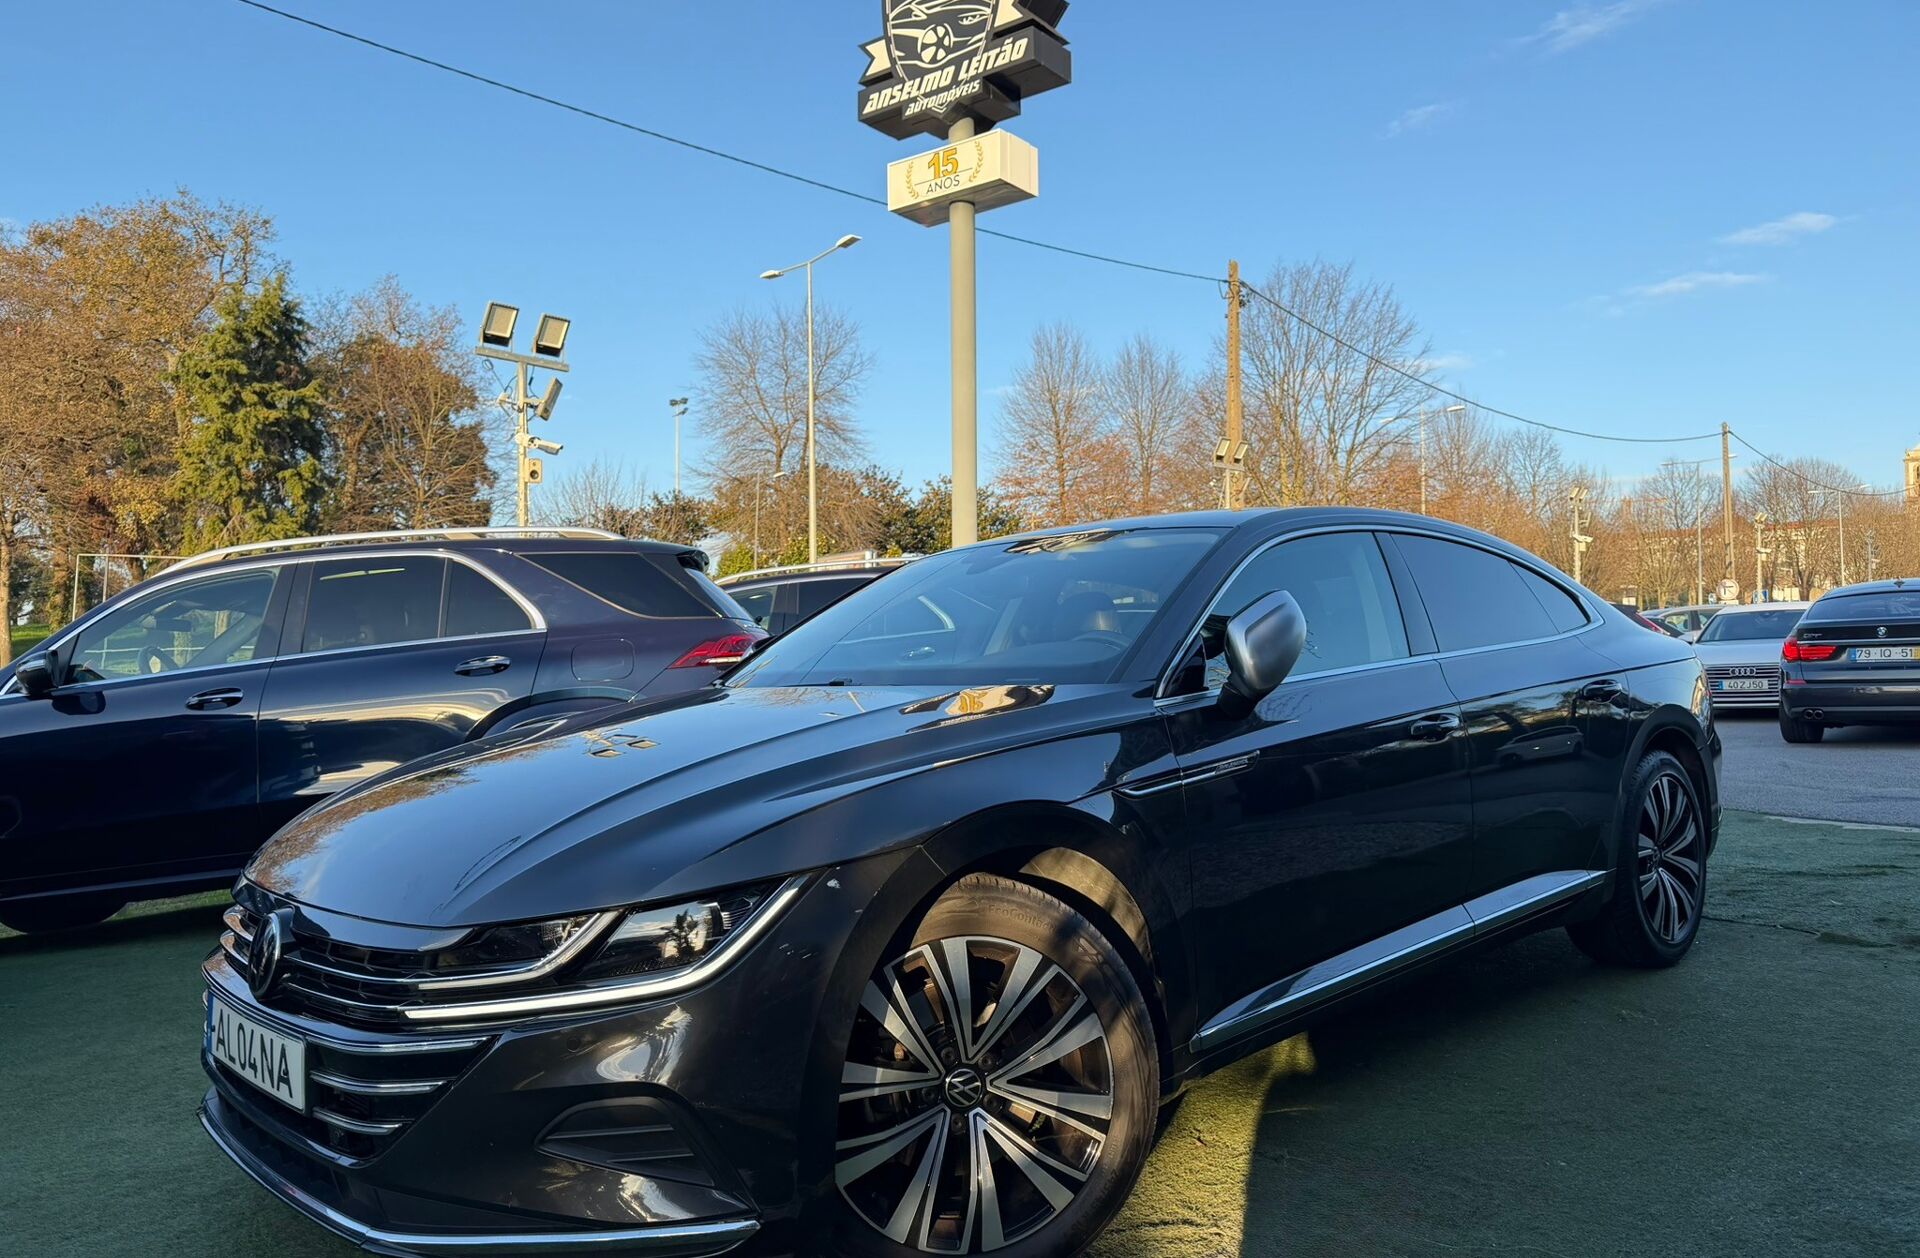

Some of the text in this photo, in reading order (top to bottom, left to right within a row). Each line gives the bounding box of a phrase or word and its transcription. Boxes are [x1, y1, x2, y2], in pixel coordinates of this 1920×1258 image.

[862, 37, 1029, 115] ANSELMO LEITÃO
[925, 174, 960, 195] ANOS
[927, 147, 959, 180] 15
[216, 1008, 293, 1099] AL04NA
